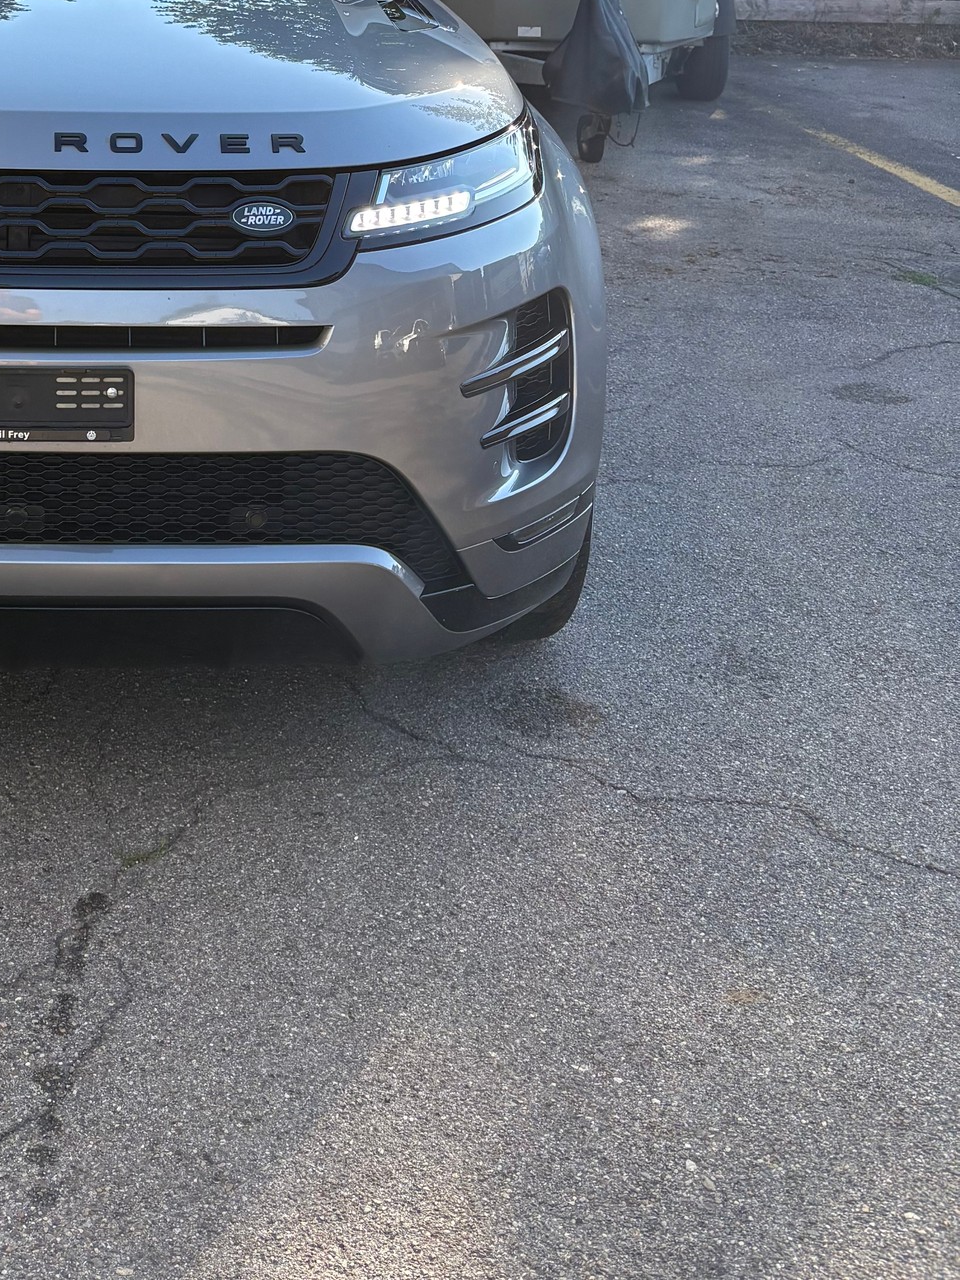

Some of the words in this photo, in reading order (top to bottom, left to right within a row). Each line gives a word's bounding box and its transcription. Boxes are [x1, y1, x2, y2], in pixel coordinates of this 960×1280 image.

[54, 132, 307, 154] ROVER
[243, 206, 275, 216] LAND
[247, 215, 285, 225] ROVER
[8, 430, 30, 441] Frey
